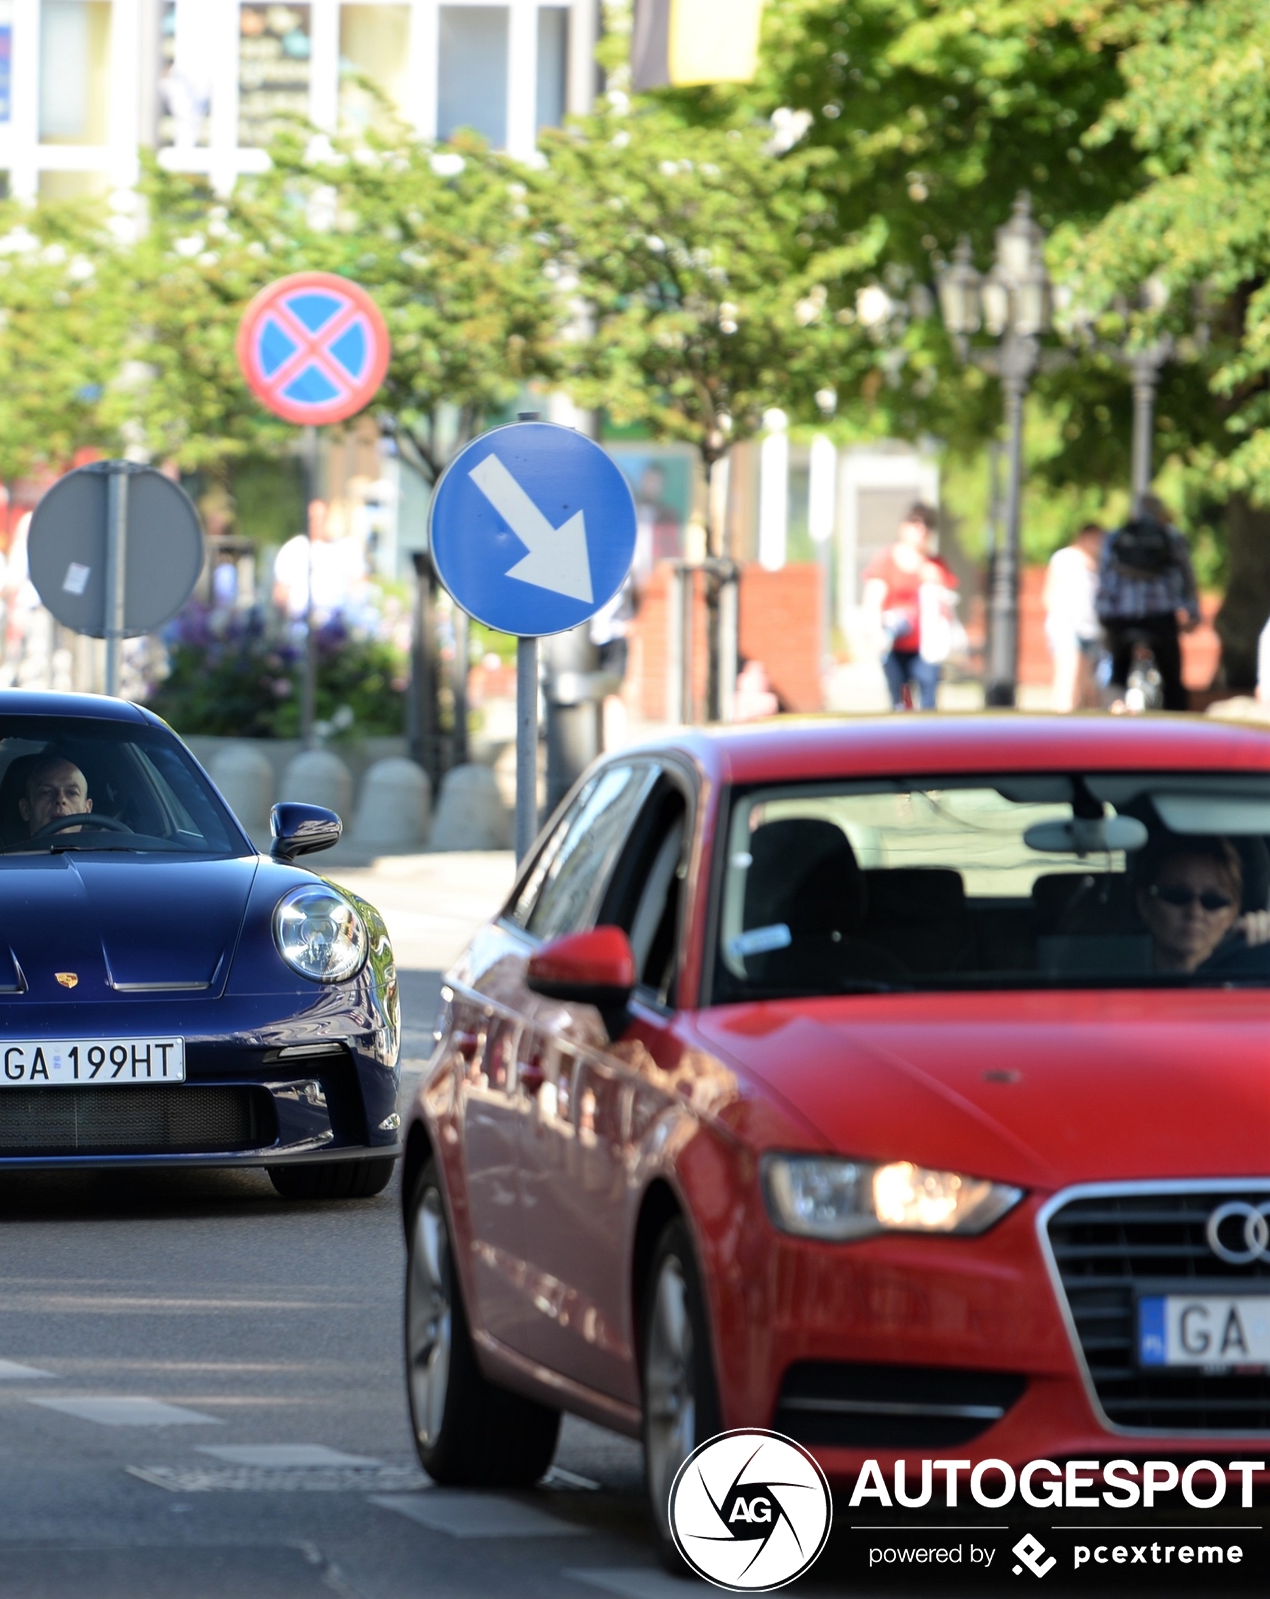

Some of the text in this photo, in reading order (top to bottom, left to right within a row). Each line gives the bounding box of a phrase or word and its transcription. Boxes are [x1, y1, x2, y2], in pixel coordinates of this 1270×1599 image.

[4, 1043, 174, 1080] GA 199HT
[1179, 1303, 1250, 1357] GA
